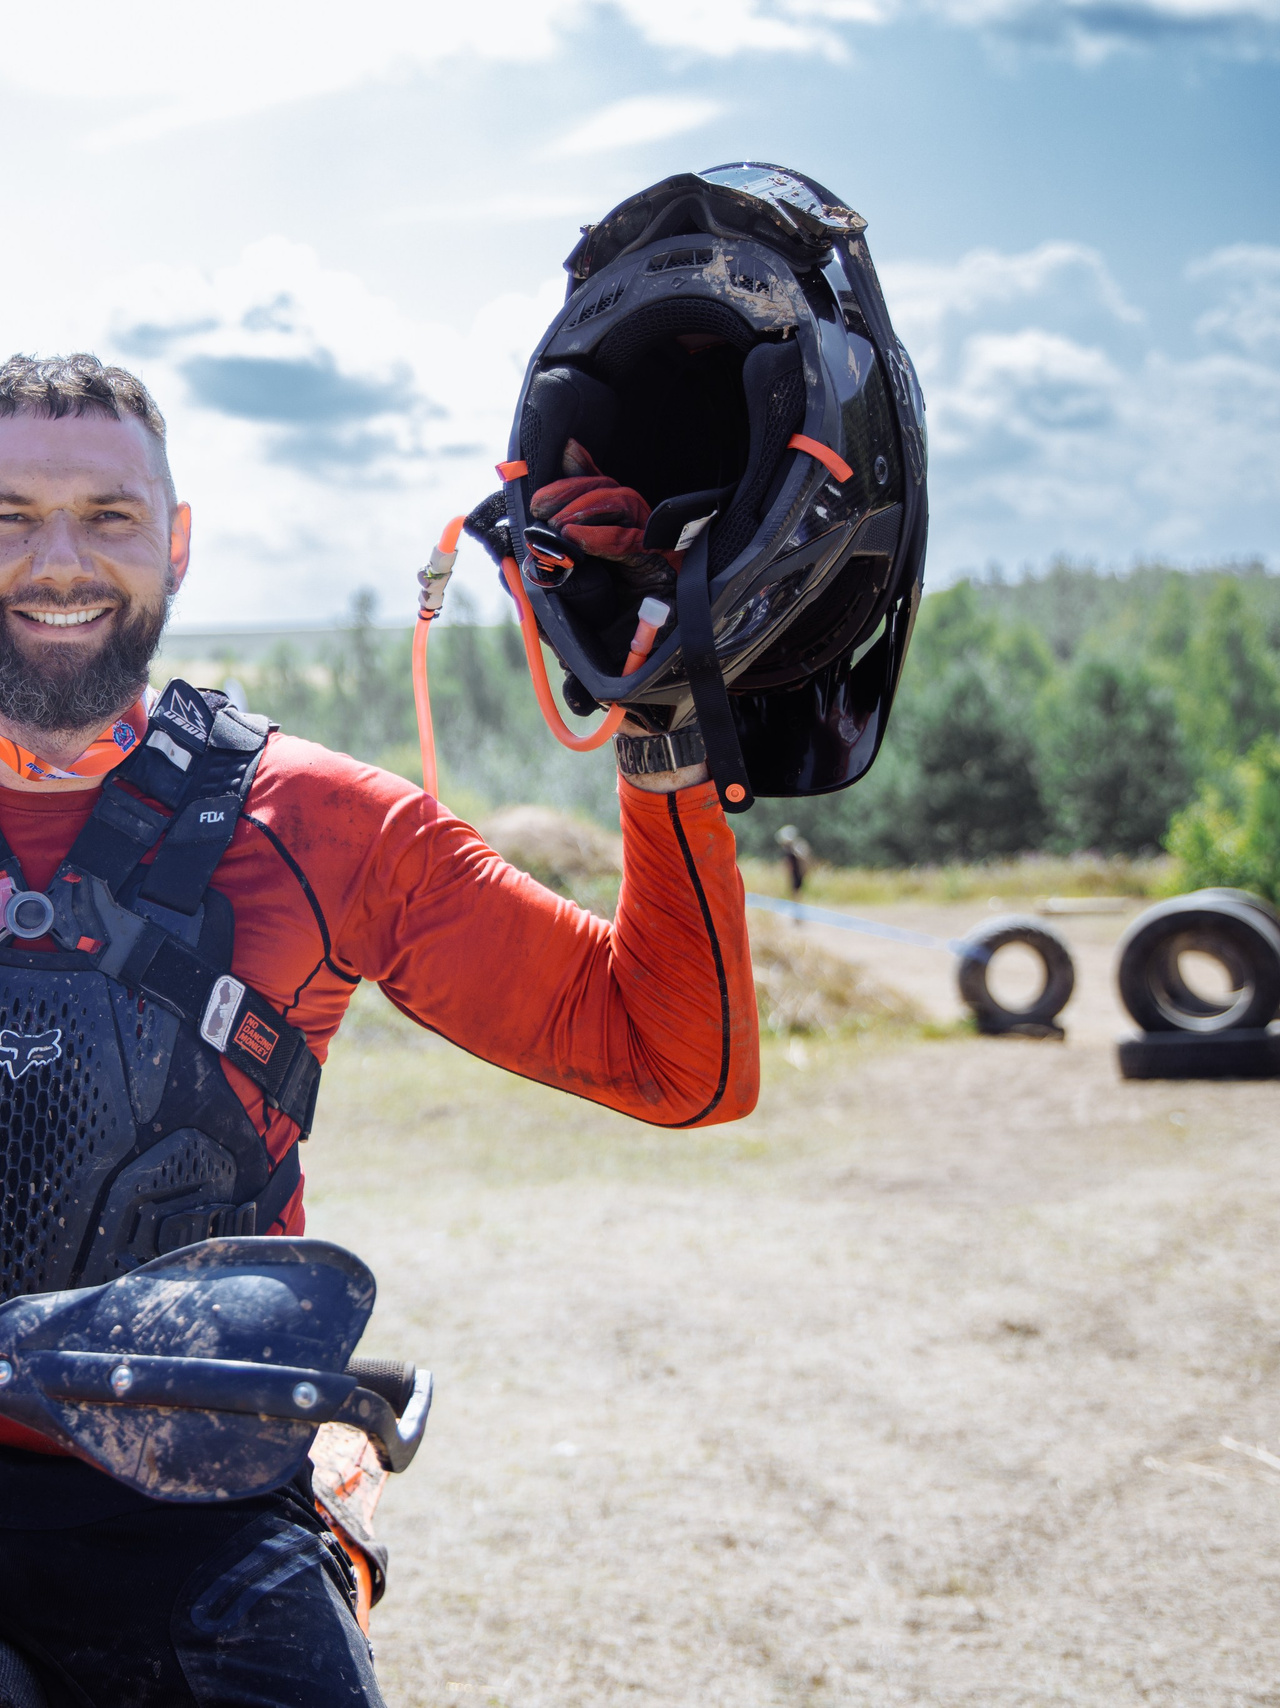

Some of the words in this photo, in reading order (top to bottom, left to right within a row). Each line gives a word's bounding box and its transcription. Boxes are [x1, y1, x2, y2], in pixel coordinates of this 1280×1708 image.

[163, 710, 208, 742] USWE
[199, 811, 225, 823] FOX
[246, 1017, 259, 1029] NO
[238, 1033, 269, 1057] MONKEY
[242, 1027, 273, 1051] DANCING
